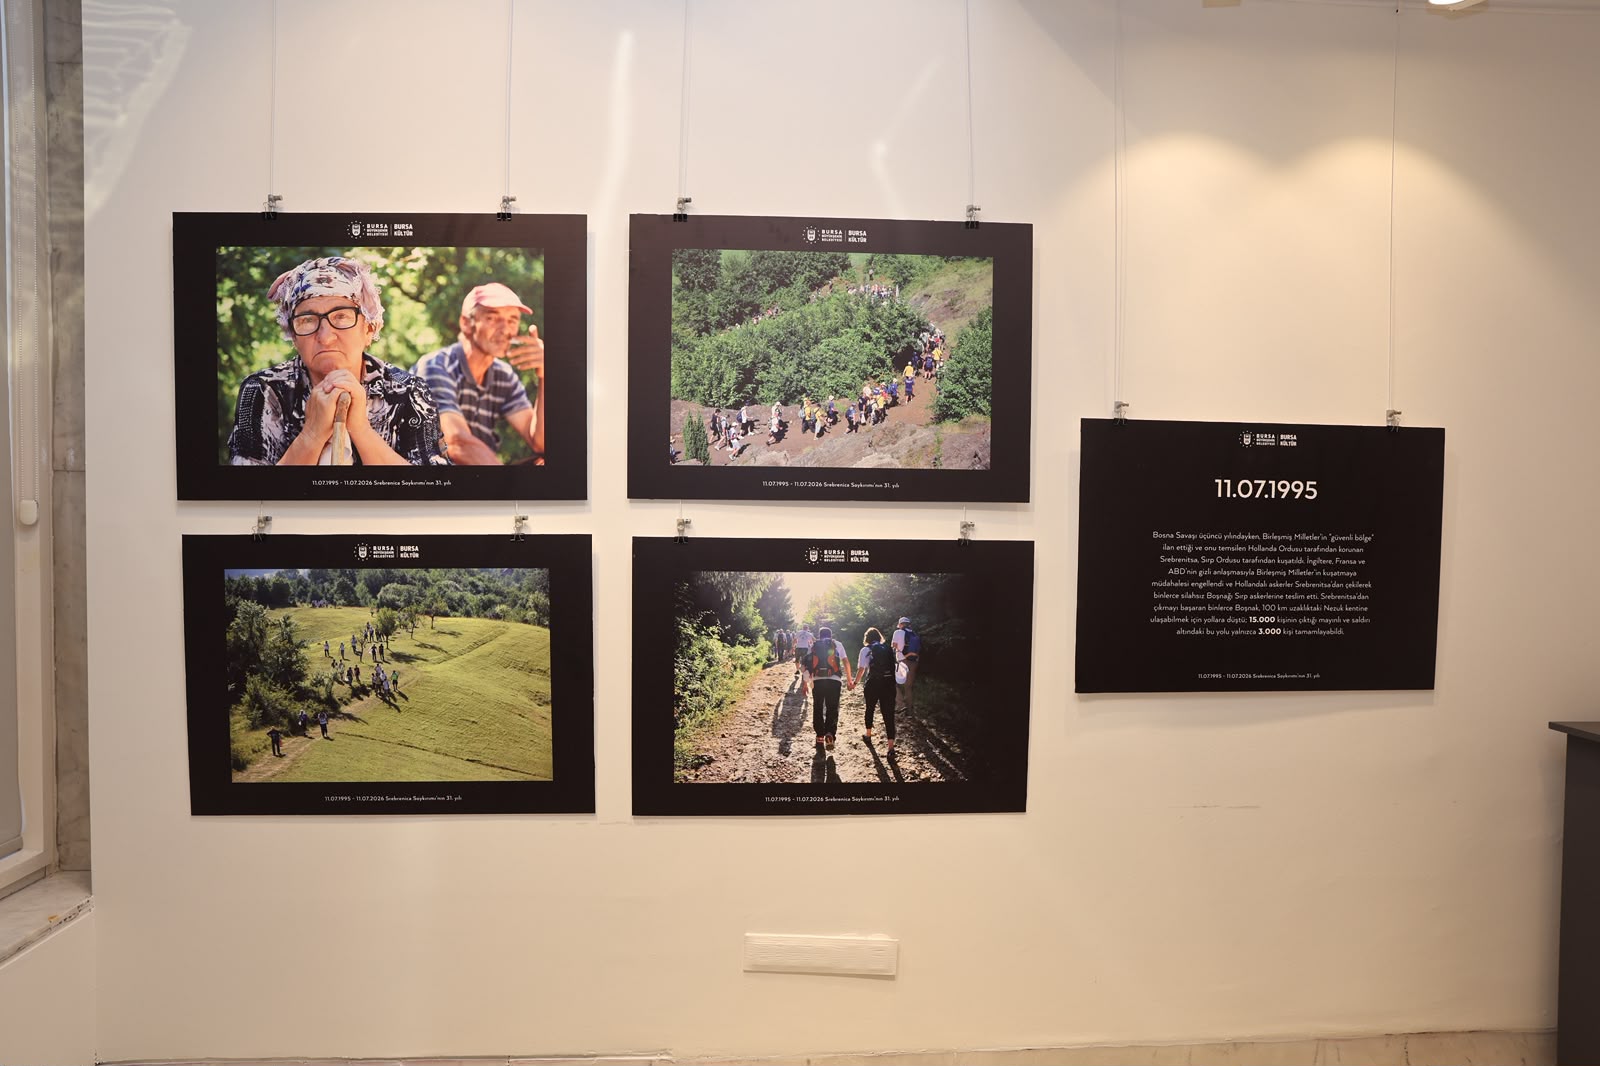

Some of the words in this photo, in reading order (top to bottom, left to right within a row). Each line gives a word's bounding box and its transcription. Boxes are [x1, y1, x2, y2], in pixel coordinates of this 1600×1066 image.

[1214, 479, 1318, 500] 11.07.1995
[1176, 531, 1197, 540] Savaşı
[1176, 544, 1194, 553] ettiği
[1201, 556, 1214, 564] Sırp
[1198, 568, 1211, 577] gizli
[1212, 568, 1254, 576] anlaşmasıyla
[1322, 569, 1357, 577] kuşatmaya
[1191, 580, 1224, 589] engellendi
[1206, 592, 1233, 601] Boşnağı
[1235, 592, 1248, 600] Sırp
[1154, 603, 1178, 612] çıkmayı
[1180, 603, 1206, 611] başaran
[1150, 616, 1189, 624] ulaşabilmek
[1204, 616, 1225, 624] yollara
[1299, 616, 1317, 625] çıktığı
[1216, 628, 1230, 636] yolu
[1231, 628, 1256, 636] yalnızca
